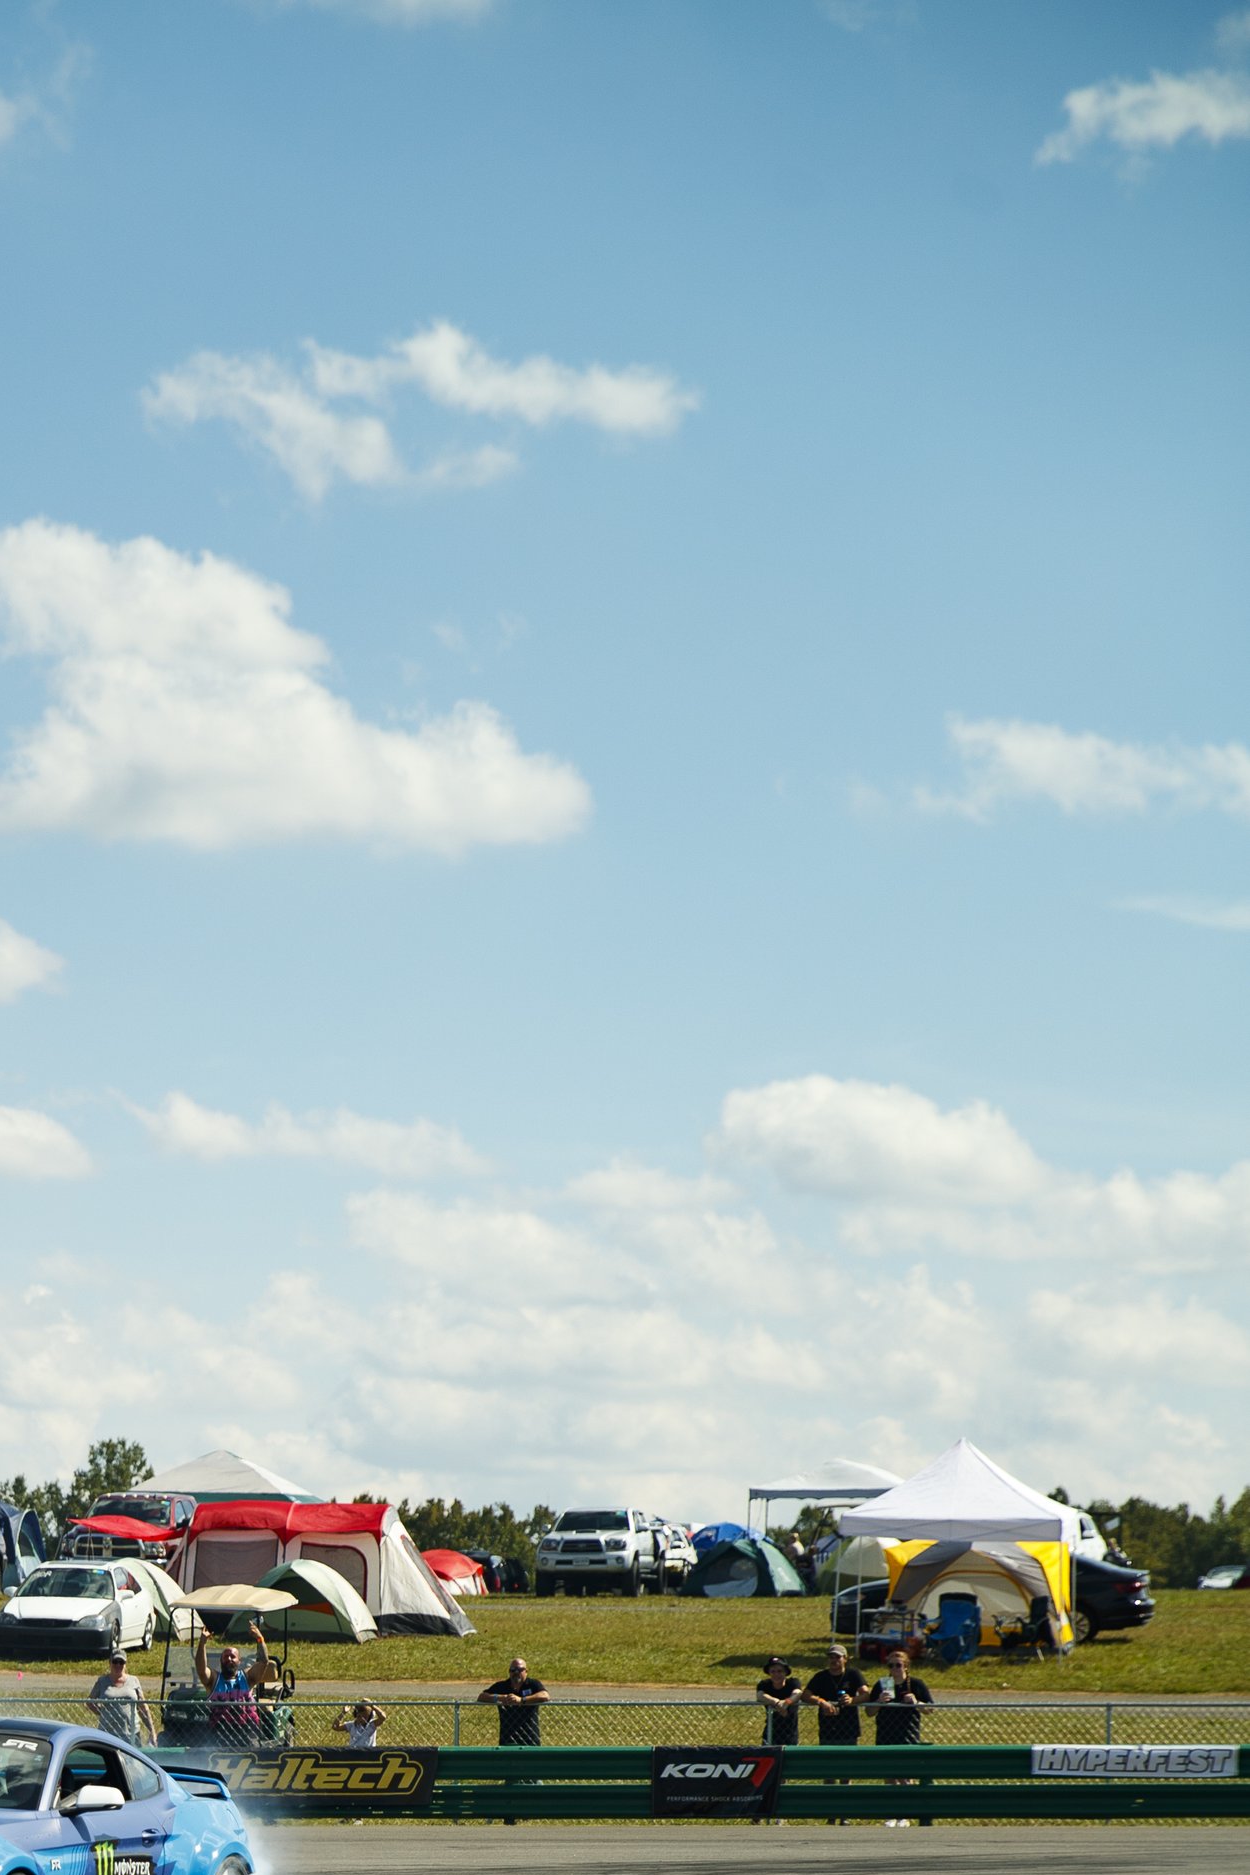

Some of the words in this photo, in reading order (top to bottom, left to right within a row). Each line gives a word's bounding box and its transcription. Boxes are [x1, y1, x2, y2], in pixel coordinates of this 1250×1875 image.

[216, 1757, 418, 1790] Haltech
[660, 1763, 755, 1778] KONI
[1038, 1747, 1232, 1774] HYPERFEST
